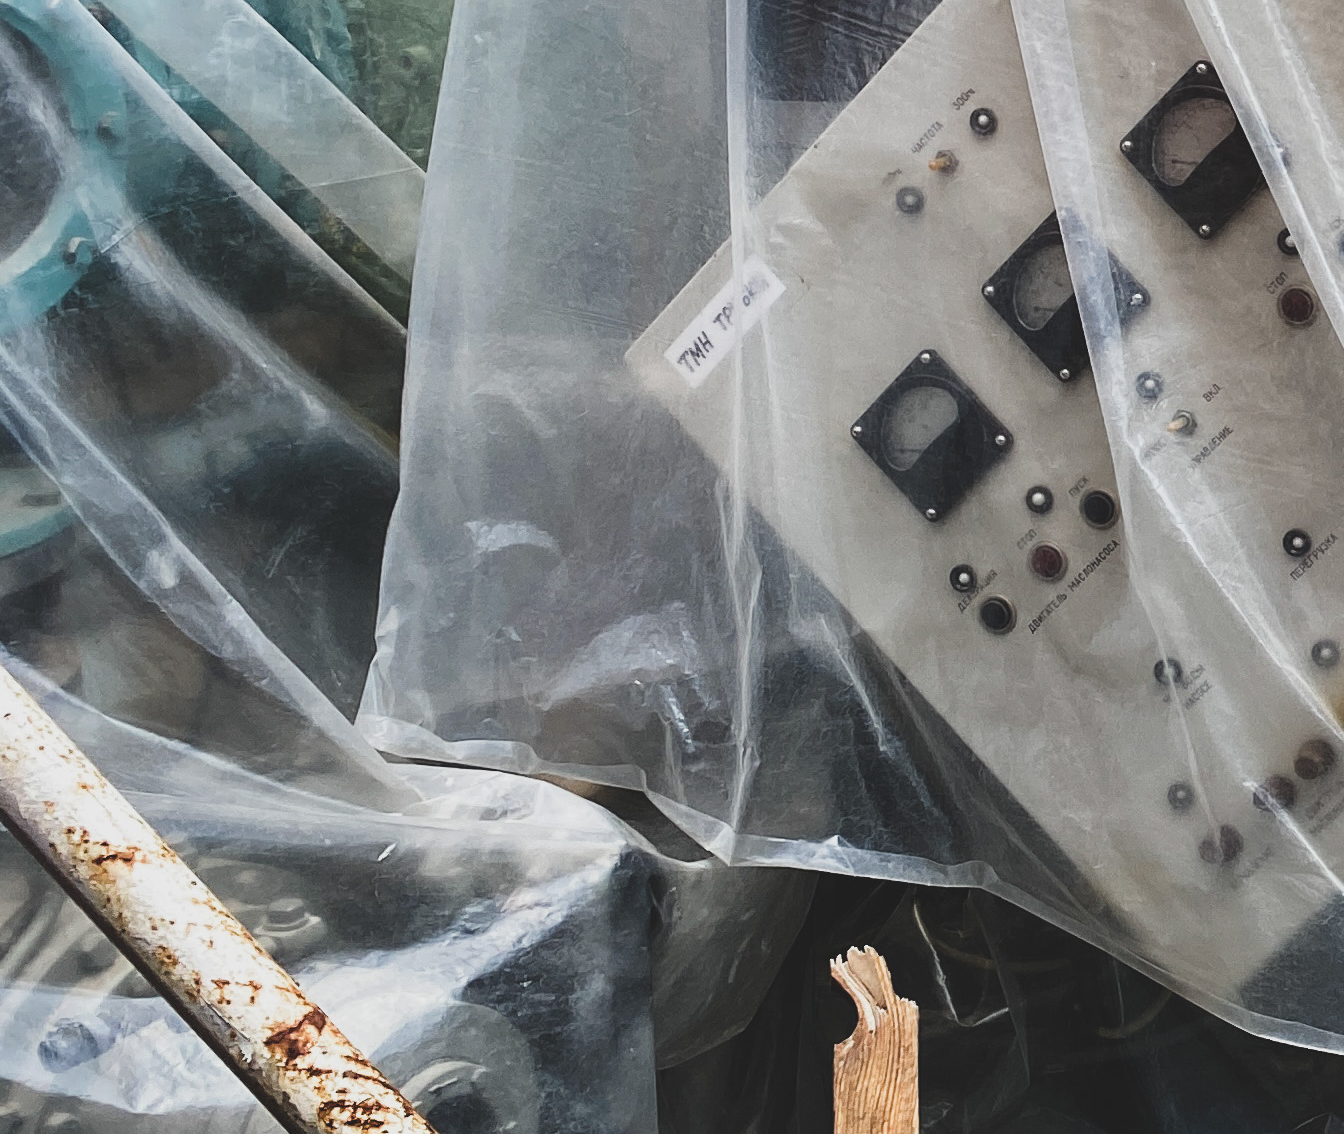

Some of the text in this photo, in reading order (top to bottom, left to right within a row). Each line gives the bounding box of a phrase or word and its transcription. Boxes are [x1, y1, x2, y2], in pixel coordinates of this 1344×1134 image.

[911, 121, 944, 154] ЧАСТОТА
[1266, 271, 1288, 295] СТОП
[677, 331, 714, 373] ТМН
[1068, 475, 1090, 498] ПУСК
[1016, 528, 1038, 551] СТОП
[1289, 533, 1339, 582] ПЕРЕГРУЗКА
[1028, 539, 1121, 635] ДВИГАТЕЛЬ МАСЛОНАСОСА
